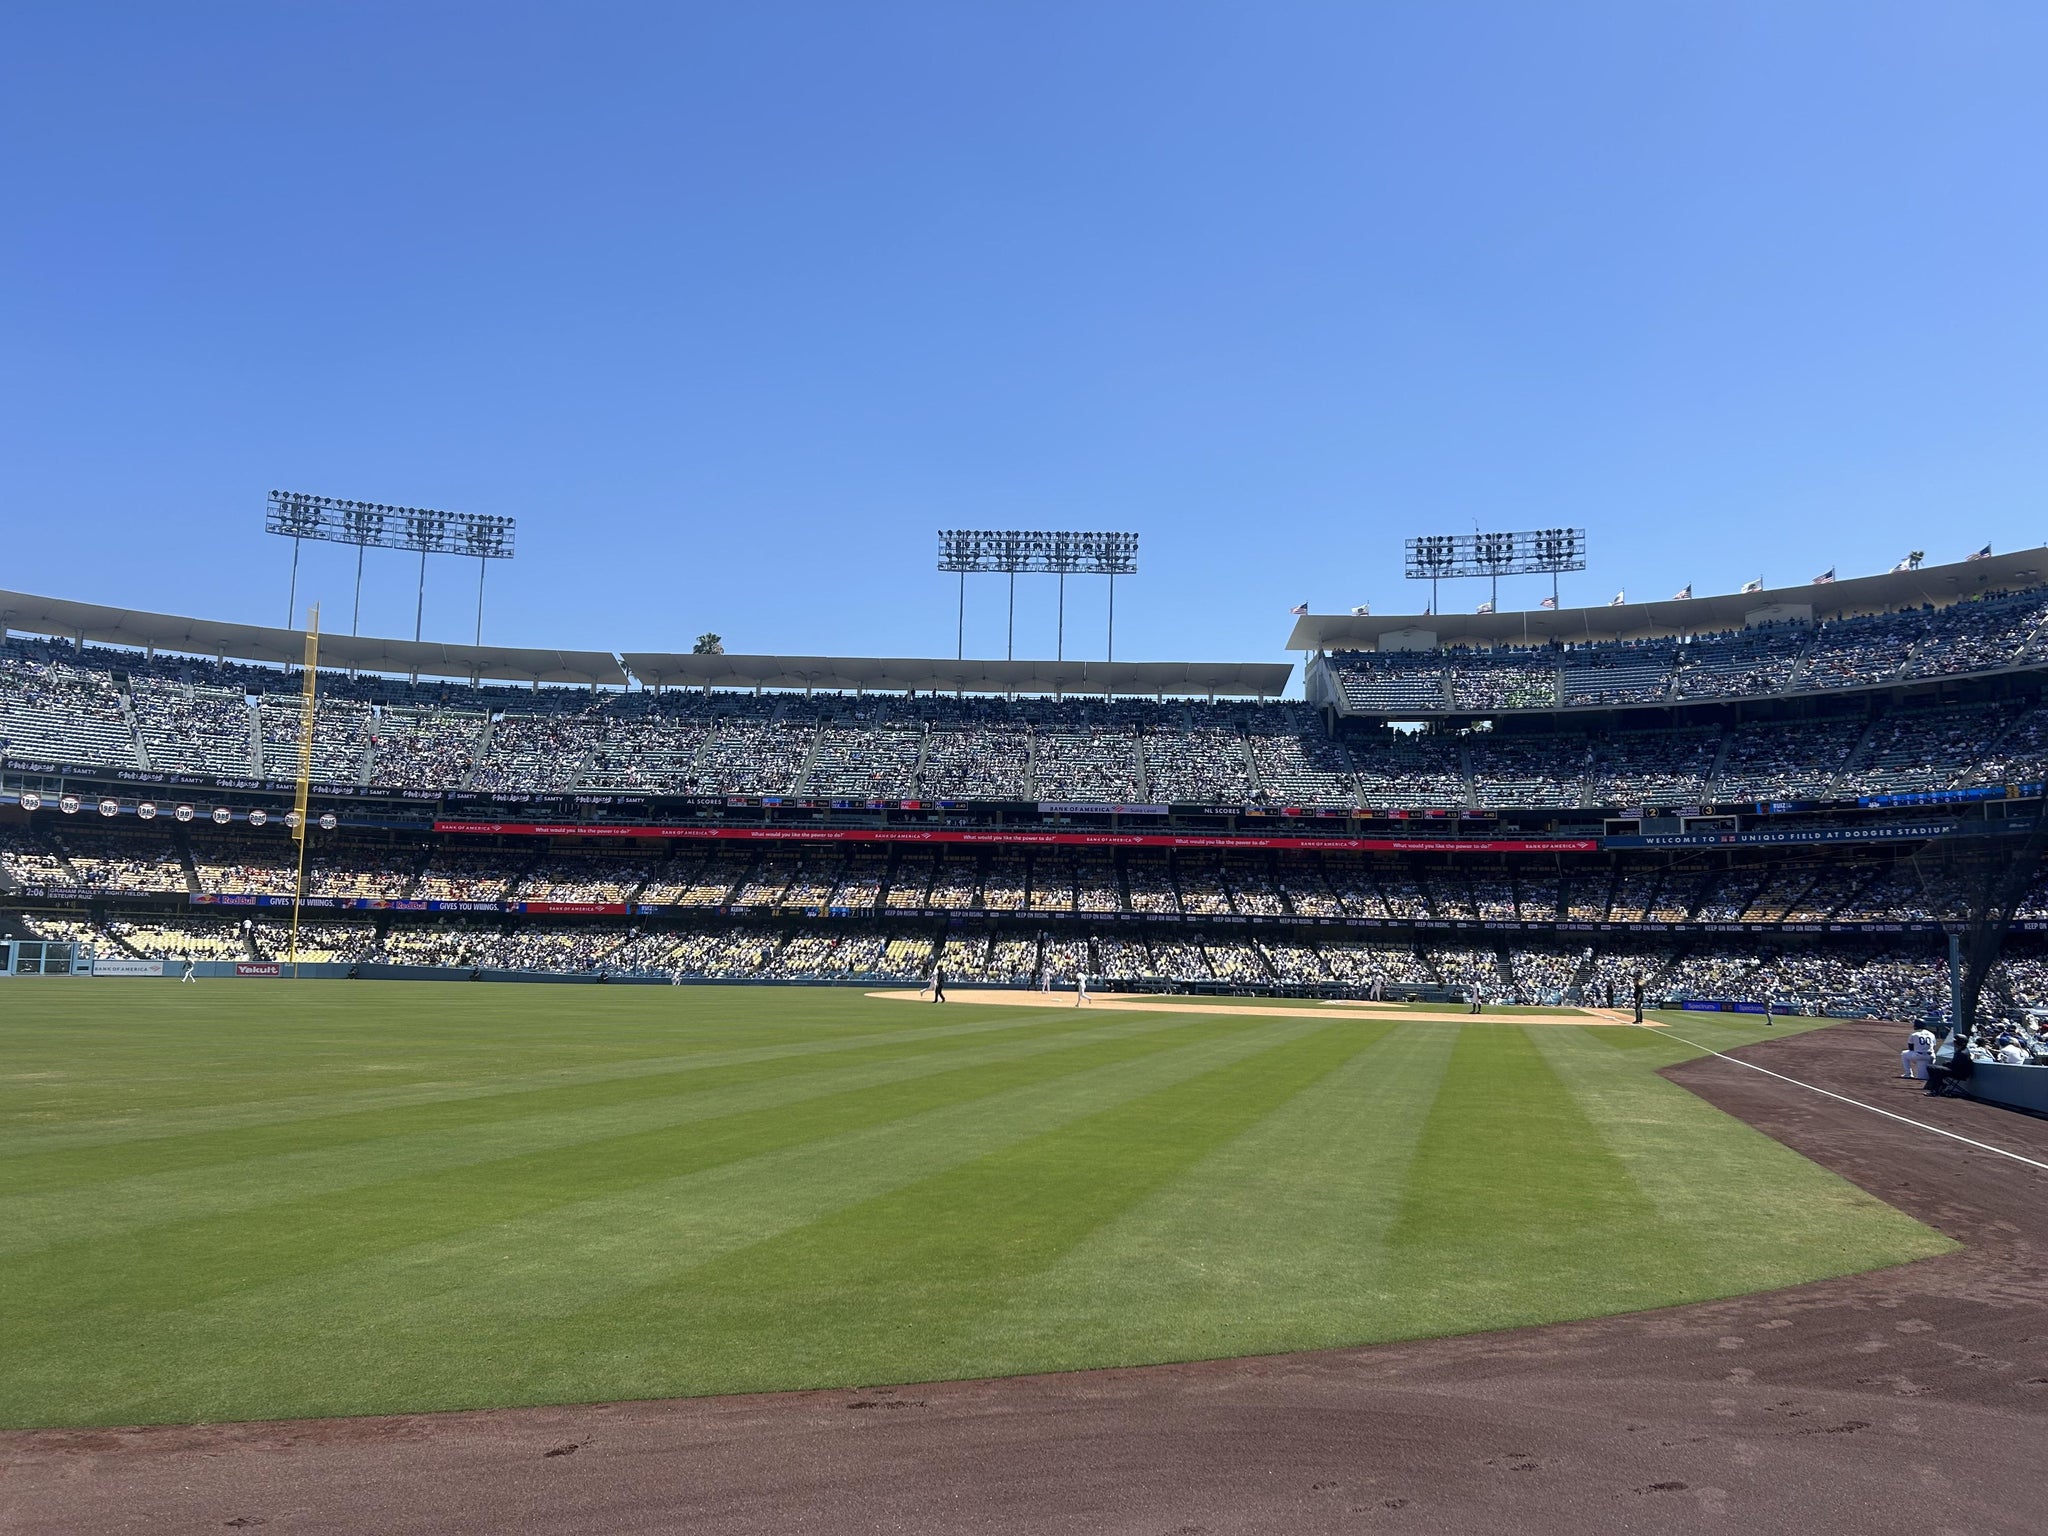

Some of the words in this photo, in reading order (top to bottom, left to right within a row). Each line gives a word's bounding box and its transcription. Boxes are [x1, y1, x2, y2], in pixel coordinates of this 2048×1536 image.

[1649, 808, 1656, 817] 2
[1705, 806, 1713, 814] 3
[1741, 833, 1785, 842] UNIQLO
[1790, 832, 1821, 840] FIELD
[1826, 831, 1839, 839] AT
[1845, 829, 1892, 838] DODGER
[1897, 826, 1950, 835] STADIUM
[1646, 836, 1697, 844] WELCOME
[1702, 835, 1715, 843] TO
[26, 888, 44, 897] 2:06
[270, 897, 289, 906] GIVES
[291, 898, 305, 906] YU
[439, 902, 457, 910] GIVES
[459, 903, 472, 911] YOU
[2024, 922, 2039, 930] KEEP
[238, 965, 278, 974] Yakult
[1919, 1036, 1932, 1045] 00
